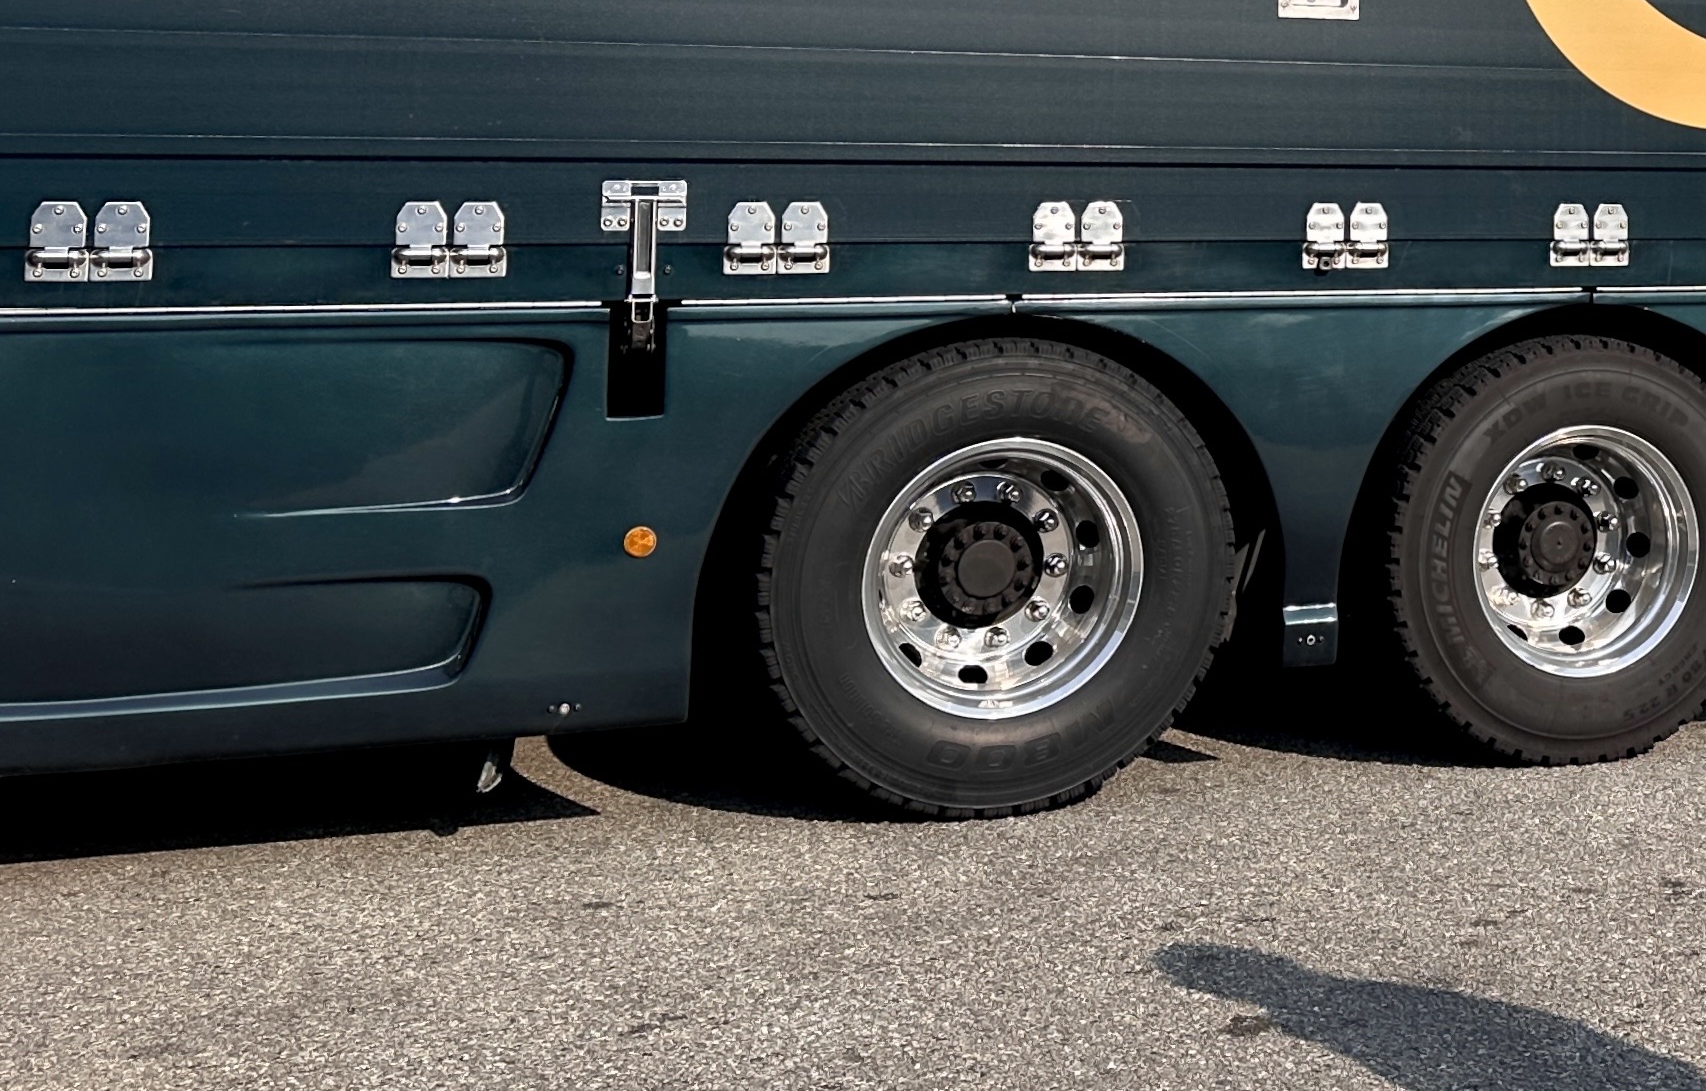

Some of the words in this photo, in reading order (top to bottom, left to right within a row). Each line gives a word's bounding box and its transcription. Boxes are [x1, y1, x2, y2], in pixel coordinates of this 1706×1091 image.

[842, 389, 1110, 508] BRIDGESTONE
[1483, 392, 1547, 445] XDW
[1563, 381, 1613, 401] ICE
[1621, 385, 1690, 427] GRIP
[1429, 476, 1467, 646] MICHELIN
